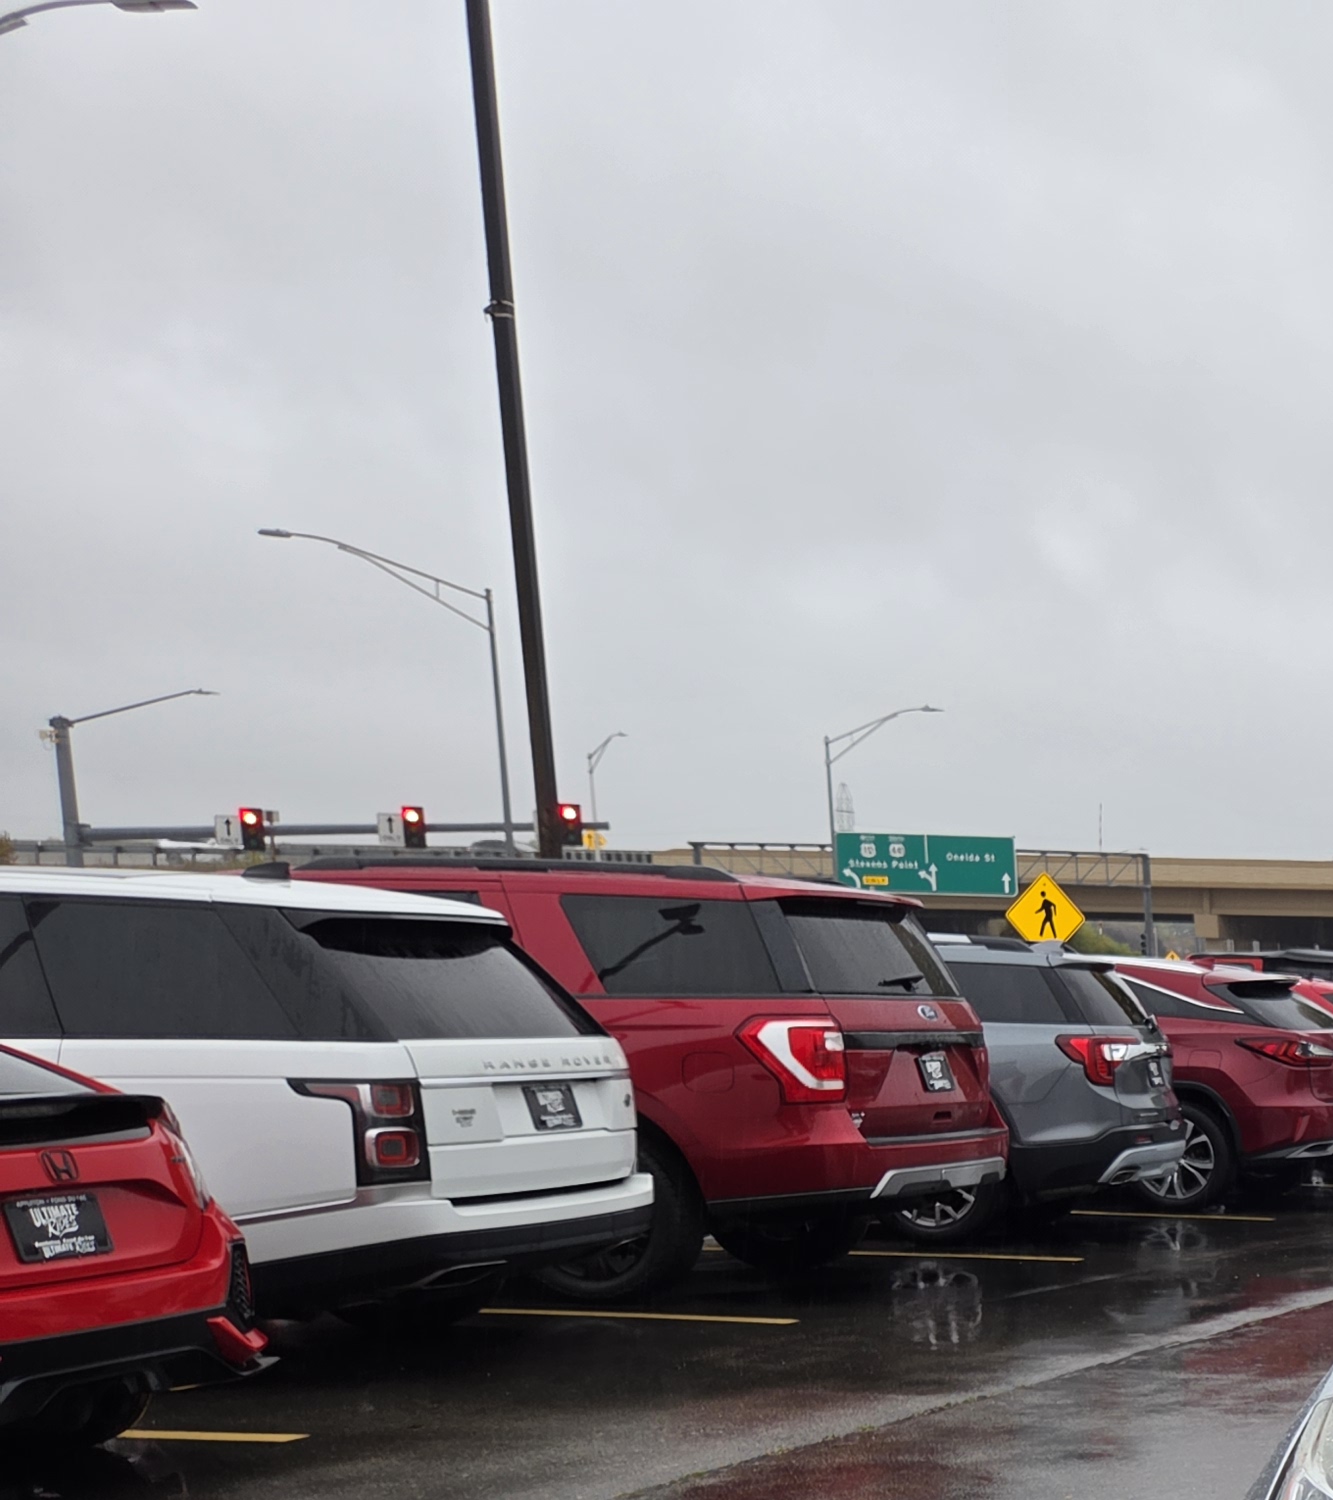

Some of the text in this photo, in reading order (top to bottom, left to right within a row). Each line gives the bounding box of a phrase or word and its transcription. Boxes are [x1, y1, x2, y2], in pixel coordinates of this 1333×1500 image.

[891, 859, 919, 870] Point
[946, 852, 996, 863] Oneida St
[482, 1054, 612, 1071] RANGE ROVER
[29, 1203, 79, 1228] ULTIMATE
